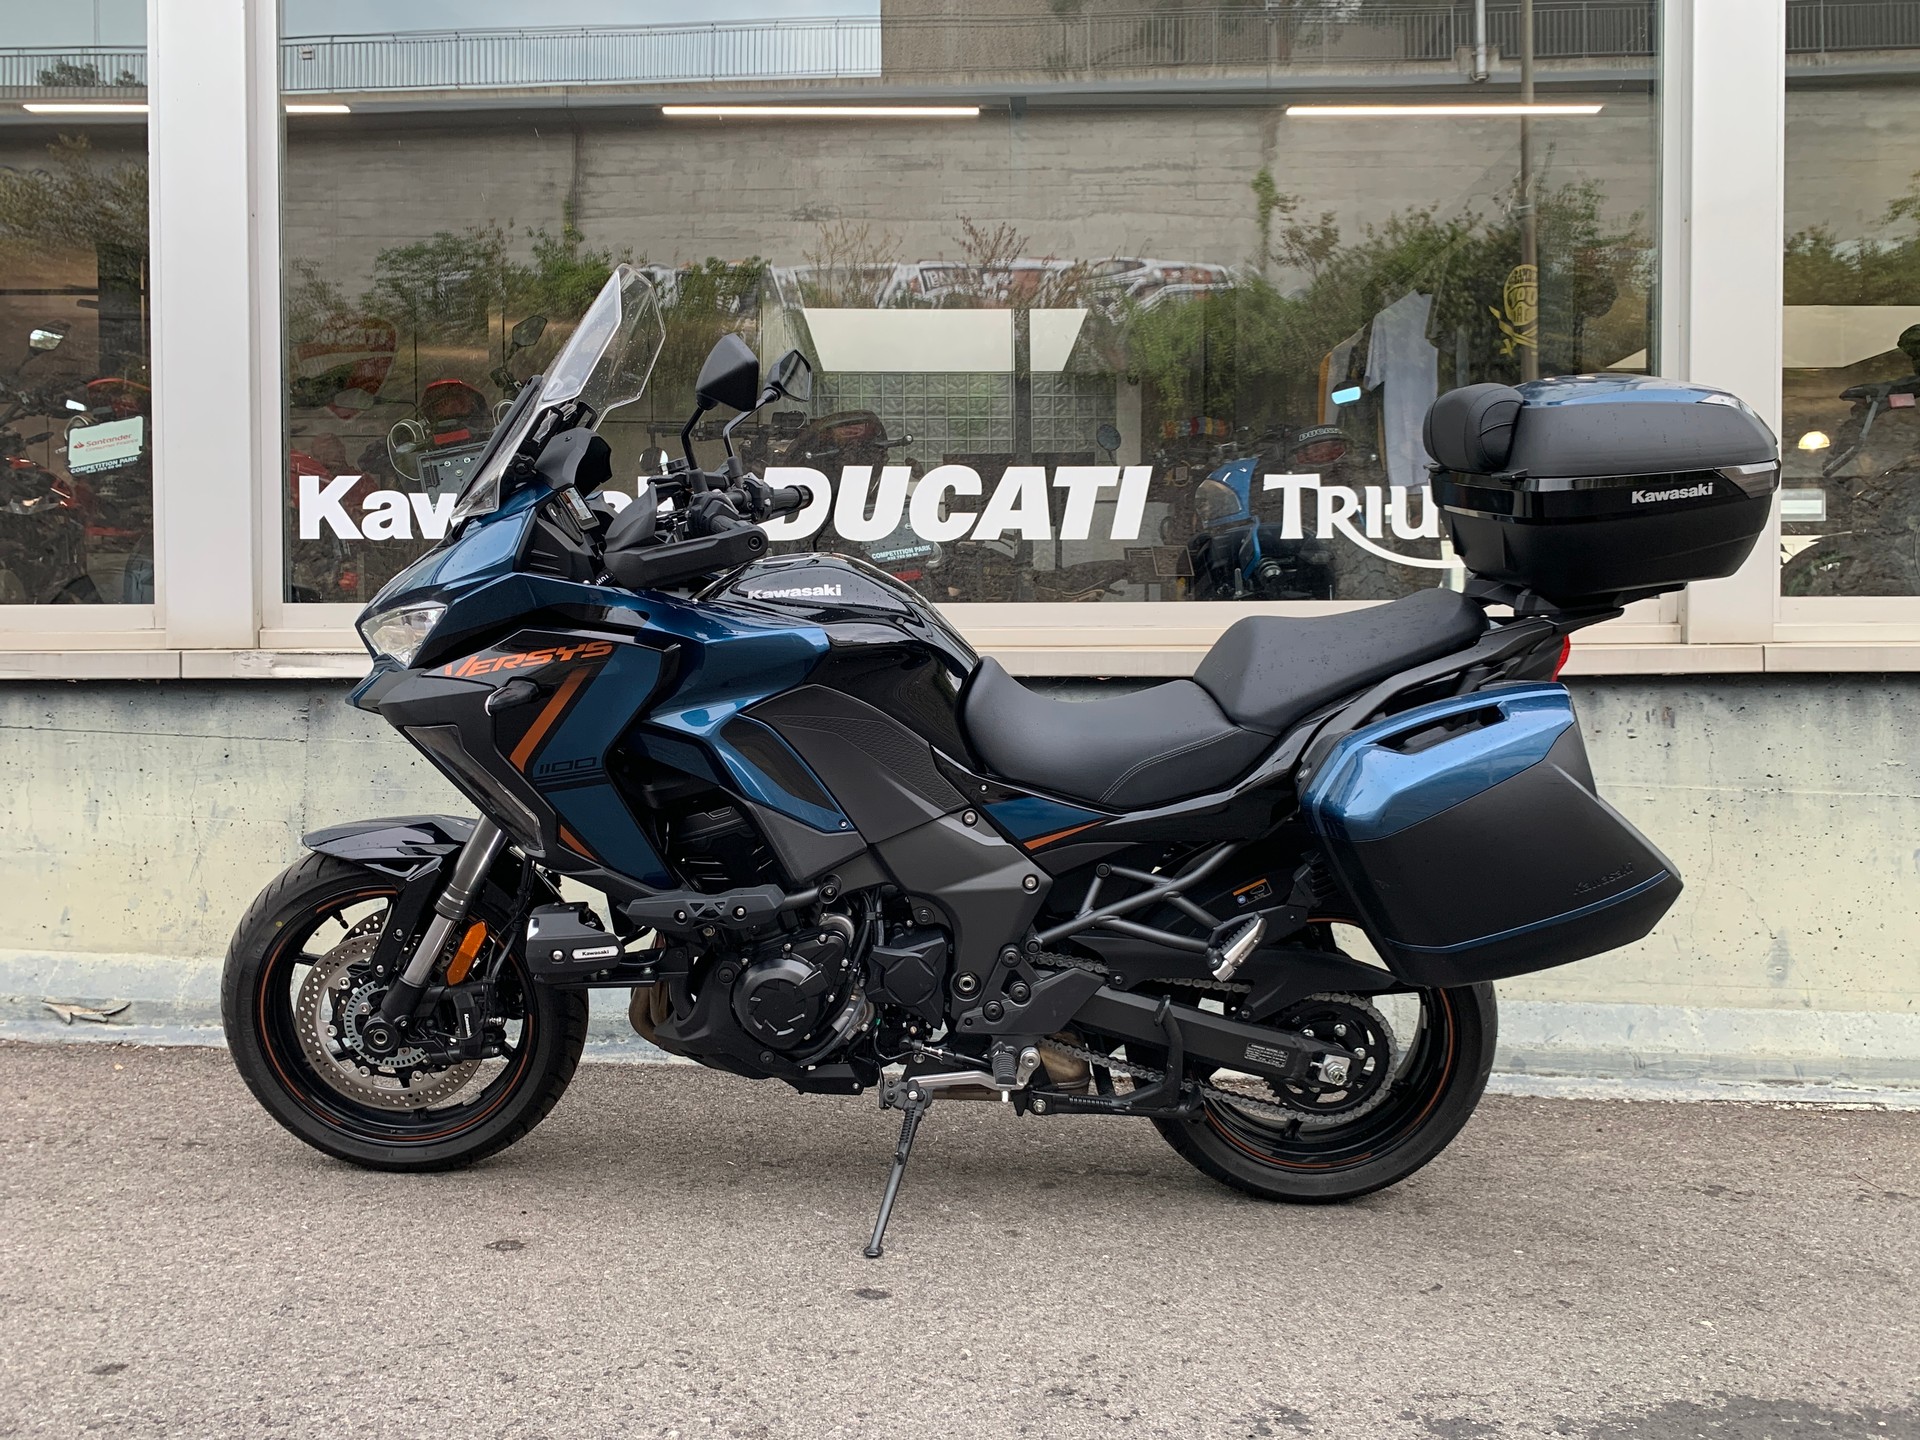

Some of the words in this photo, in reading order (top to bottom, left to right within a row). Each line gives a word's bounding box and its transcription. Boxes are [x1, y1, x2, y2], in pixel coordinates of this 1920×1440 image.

[86, 433, 133, 447] Santander
[70, 459, 118, 474] COMPETITION
[119, 455, 138, 465] PARK
[1631, 482, 1714, 504] Kawasaki
[757, 465, 1153, 542] DUCATI
[1263, 474, 1466, 569] TRIU
[871, 547, 914, 559] COMPETITION
[914, 544, 932, 553] PARK
[747, 584, 842, 600] Kawasaki
[444, 641, 613, 678] VERSYS
[539, 756, 597, 775] 1100
[582, 949, 610, 957] Kawasaki
